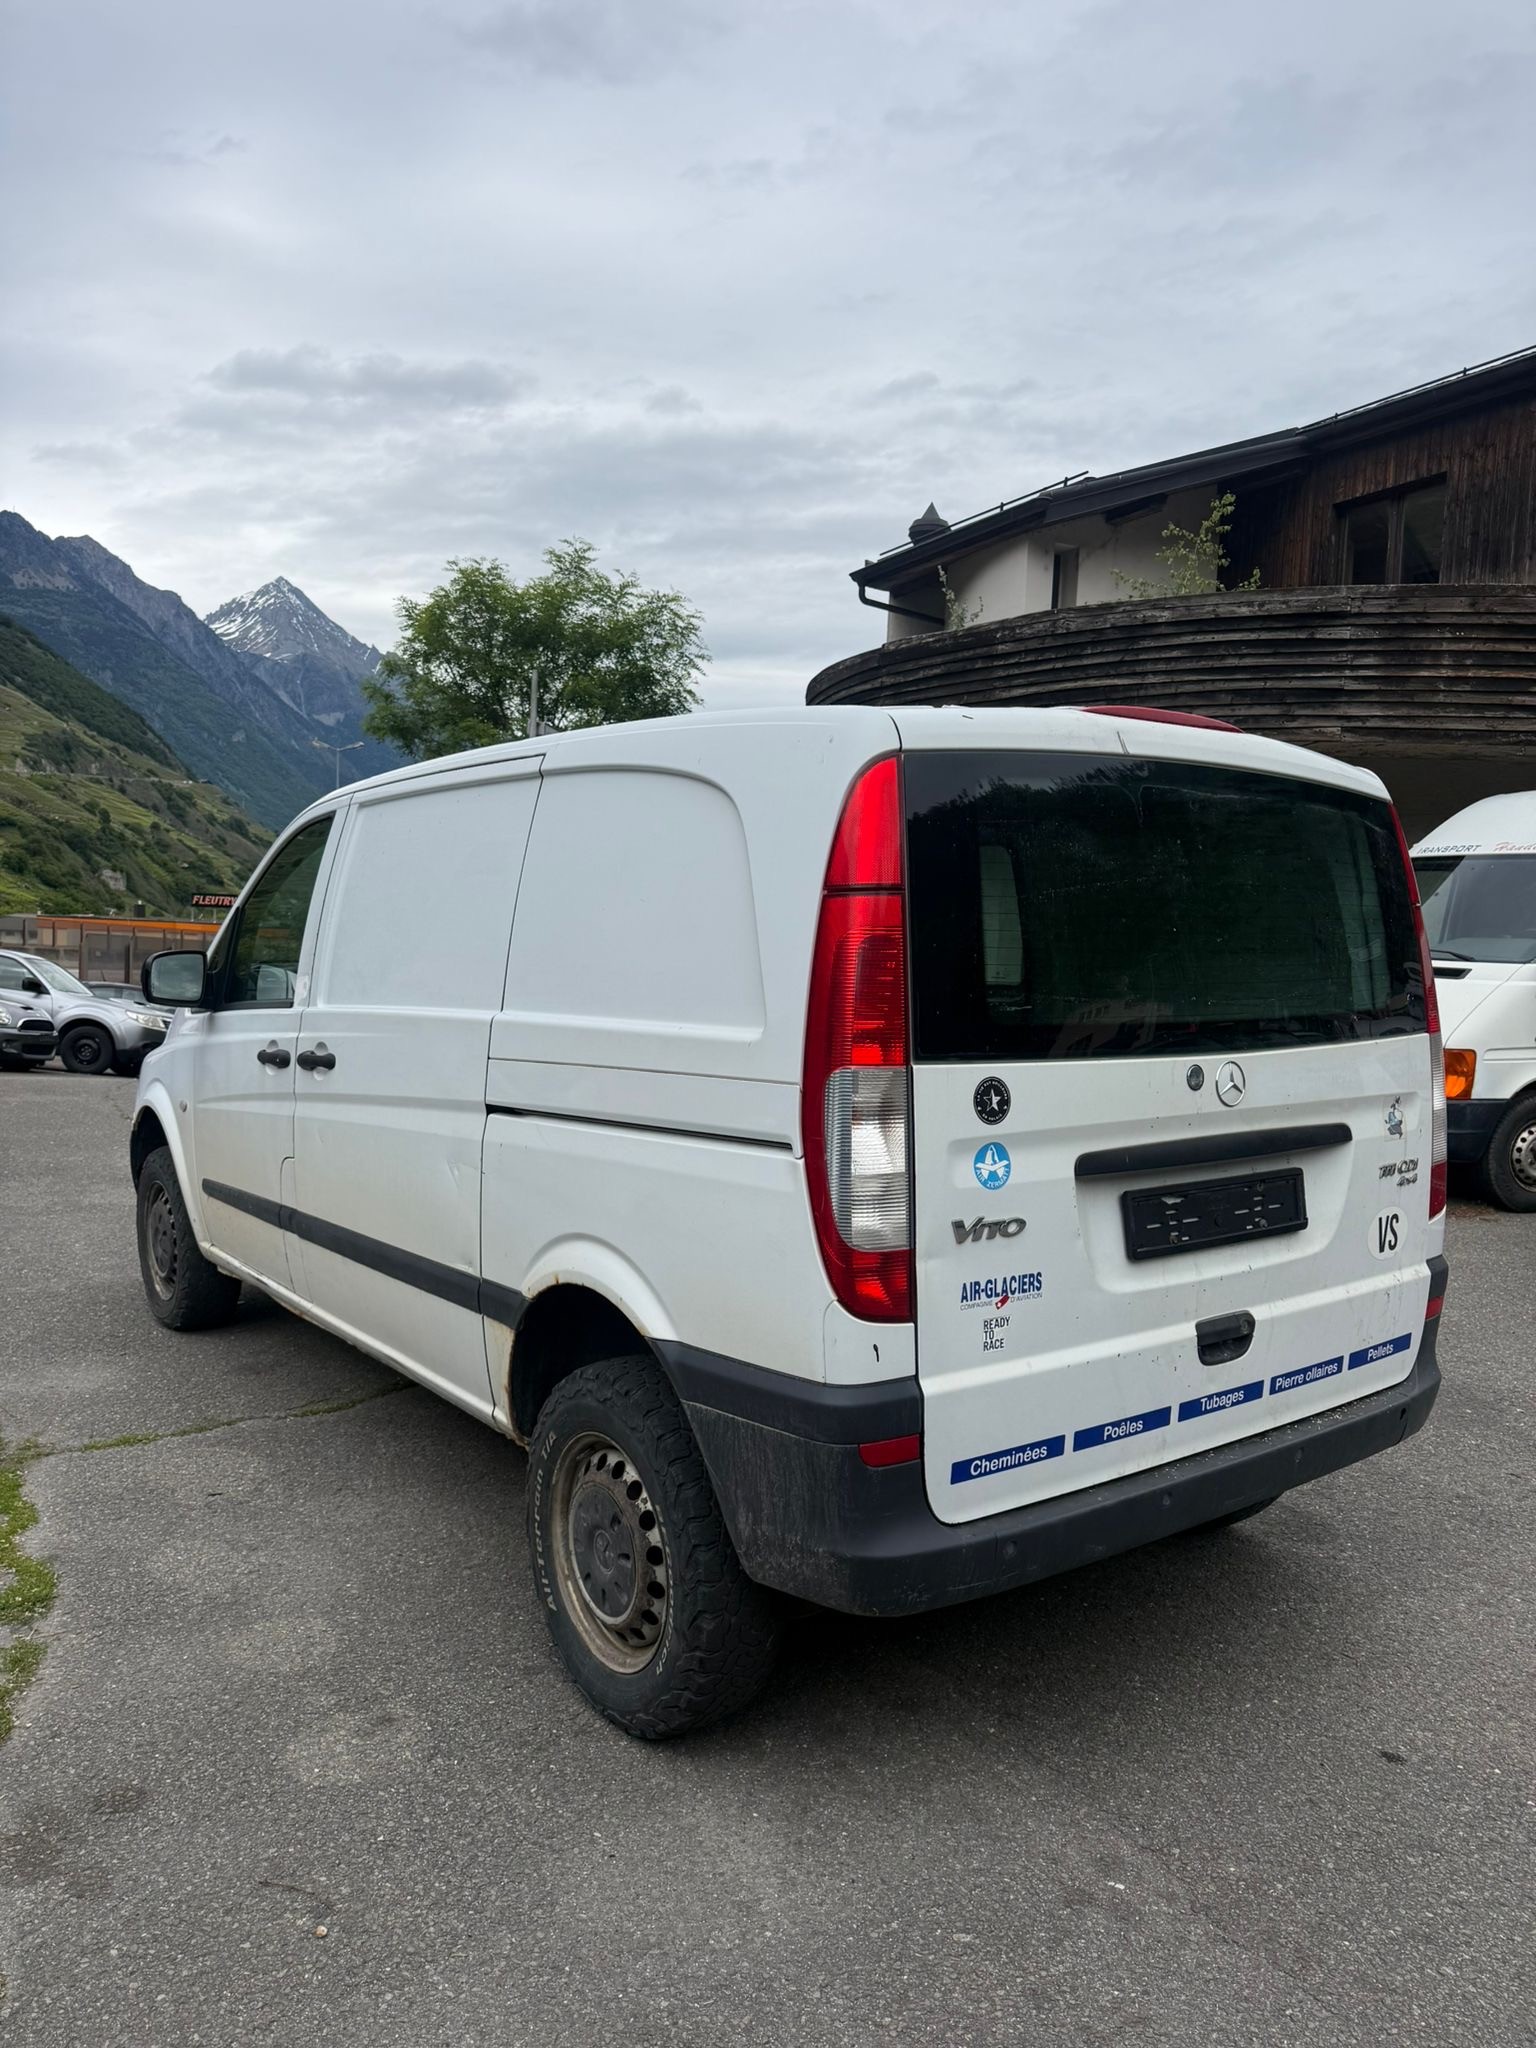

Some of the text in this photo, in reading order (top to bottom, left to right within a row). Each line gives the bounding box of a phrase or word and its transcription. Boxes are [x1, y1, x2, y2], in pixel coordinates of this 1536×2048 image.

[1378, 1213, 1400, 1254] VS
[960, 1271, 1042, 1303] AIR-GLACIERS
[983, 1316, 1011, 1331] READY
[984, 1329, 995, 1341] TO
[983, 1338, 1005, 1352] RACE
[1367, 1343, 1394, 1362] Pellets
[1275, 1363, 1338, 1391] Pierre ollaires
[1200, 1388, 1244, 1412] Tubages
[1103, 1418, 1144, 1441] Poêles
[970, 1445, 1048, 1476] Cheminées
